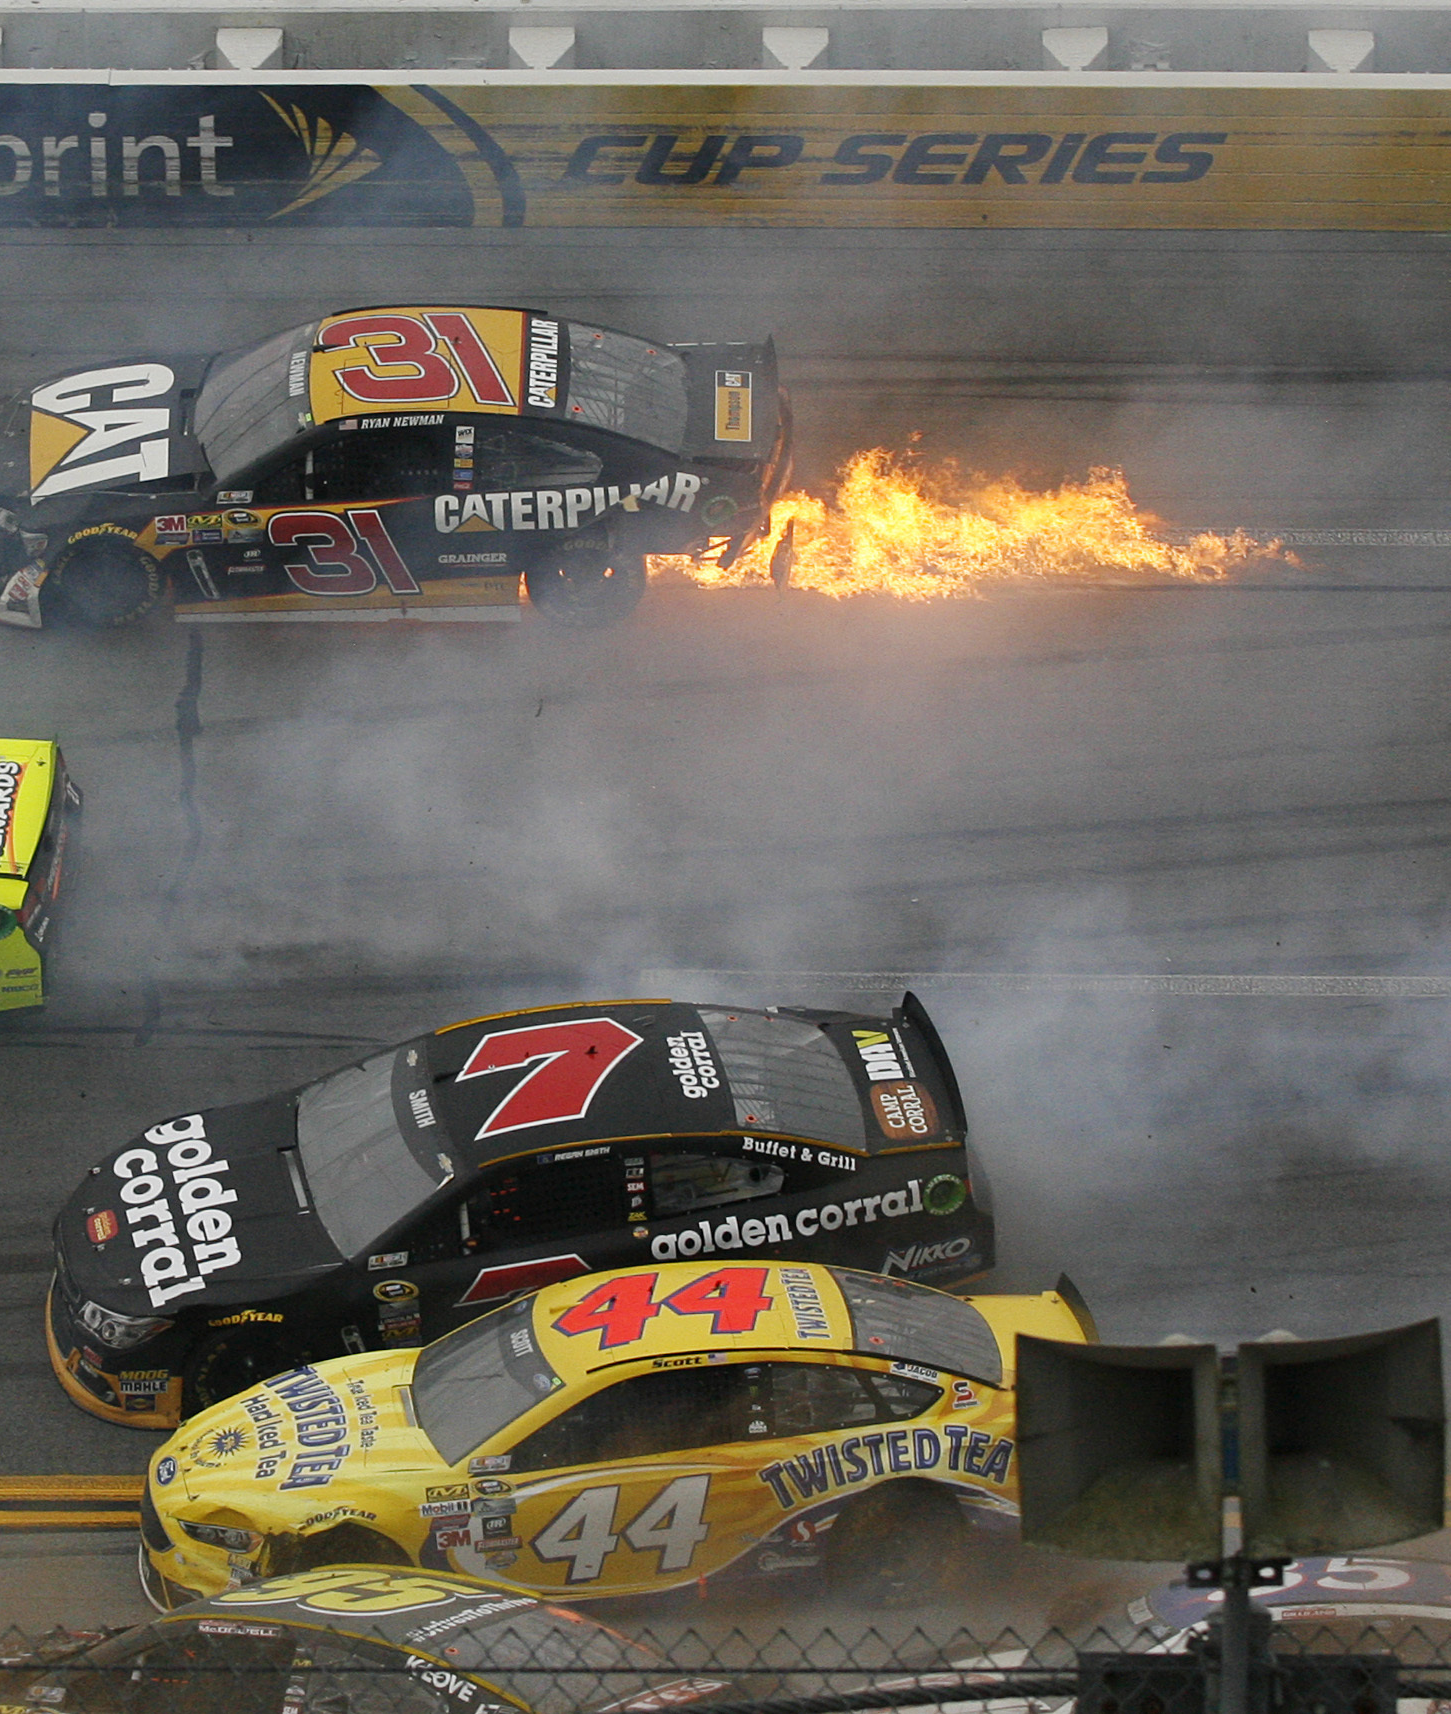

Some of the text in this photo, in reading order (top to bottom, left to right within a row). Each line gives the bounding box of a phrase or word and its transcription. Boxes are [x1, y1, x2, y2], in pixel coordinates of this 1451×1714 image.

[561, 132, 1228, 185] CUP SERIES
[288, 350, 307, 398] NEWMAN
[317, 313, 517, 407] 31
[527, 316, 559, 409] CATERPILLAR
[30, 362, 175, 507] CAT
[360, 414, 445, 430] RYAN NEWMAN
[67, 522, 138, 545] GOODYEAR
[156, 516, 186, 533] 3M
[267, 507, 420, 595] 31
[438, 552, 508, 565] GRAINGER
[454, 1017, 644, 1141] 7
[667, 1036, 708, 1099] golden
[684, 1031, 720, 1089] corral
[409, 1088, 436, 1129] SMITH
[879, 1093, 906, 1129] CAMP
[900, 1085, 928, 1134] CORRAL
[584, 1146, 611, 1157] SMITH
[742, 1136, 857, 1171] Buffet & Grill
[144, 1113, 242, 1275] golden
[795, 1179, 924, 1237] corral
[113, 1147, 206, 1308] corral
[881, 1237, 971, 1276] NIKKO
[208, 1309, 285, 1328] GOODYEAR
[551, 1267, 773, 1350] 44
[785, 1285, 831, 1339] TWISTED
[510, 1328, 534, 1358] SCOTT
[119, 1370, 170, 1380] MOOG
[120, 1380, 167, 1391] MAHLE
[907, 1364, 938, 1378] JACOB
[263, 1365, 348, 1447] TWISTED
[240, 1393, 288, 1479] Hard Iced Tea
[945, 1425, 1014, 1485] TEA
[278, 1444, 351, 1491] TEA
[760, 1428, 942, 1509] TWISTED
[299, 1506, 377, 1531] OODYEAR
[421, 1503, 455, 1516] Mobil
[529, 1473, 712, 1585] 44
[437, 1529, 471, 1550] 3M
